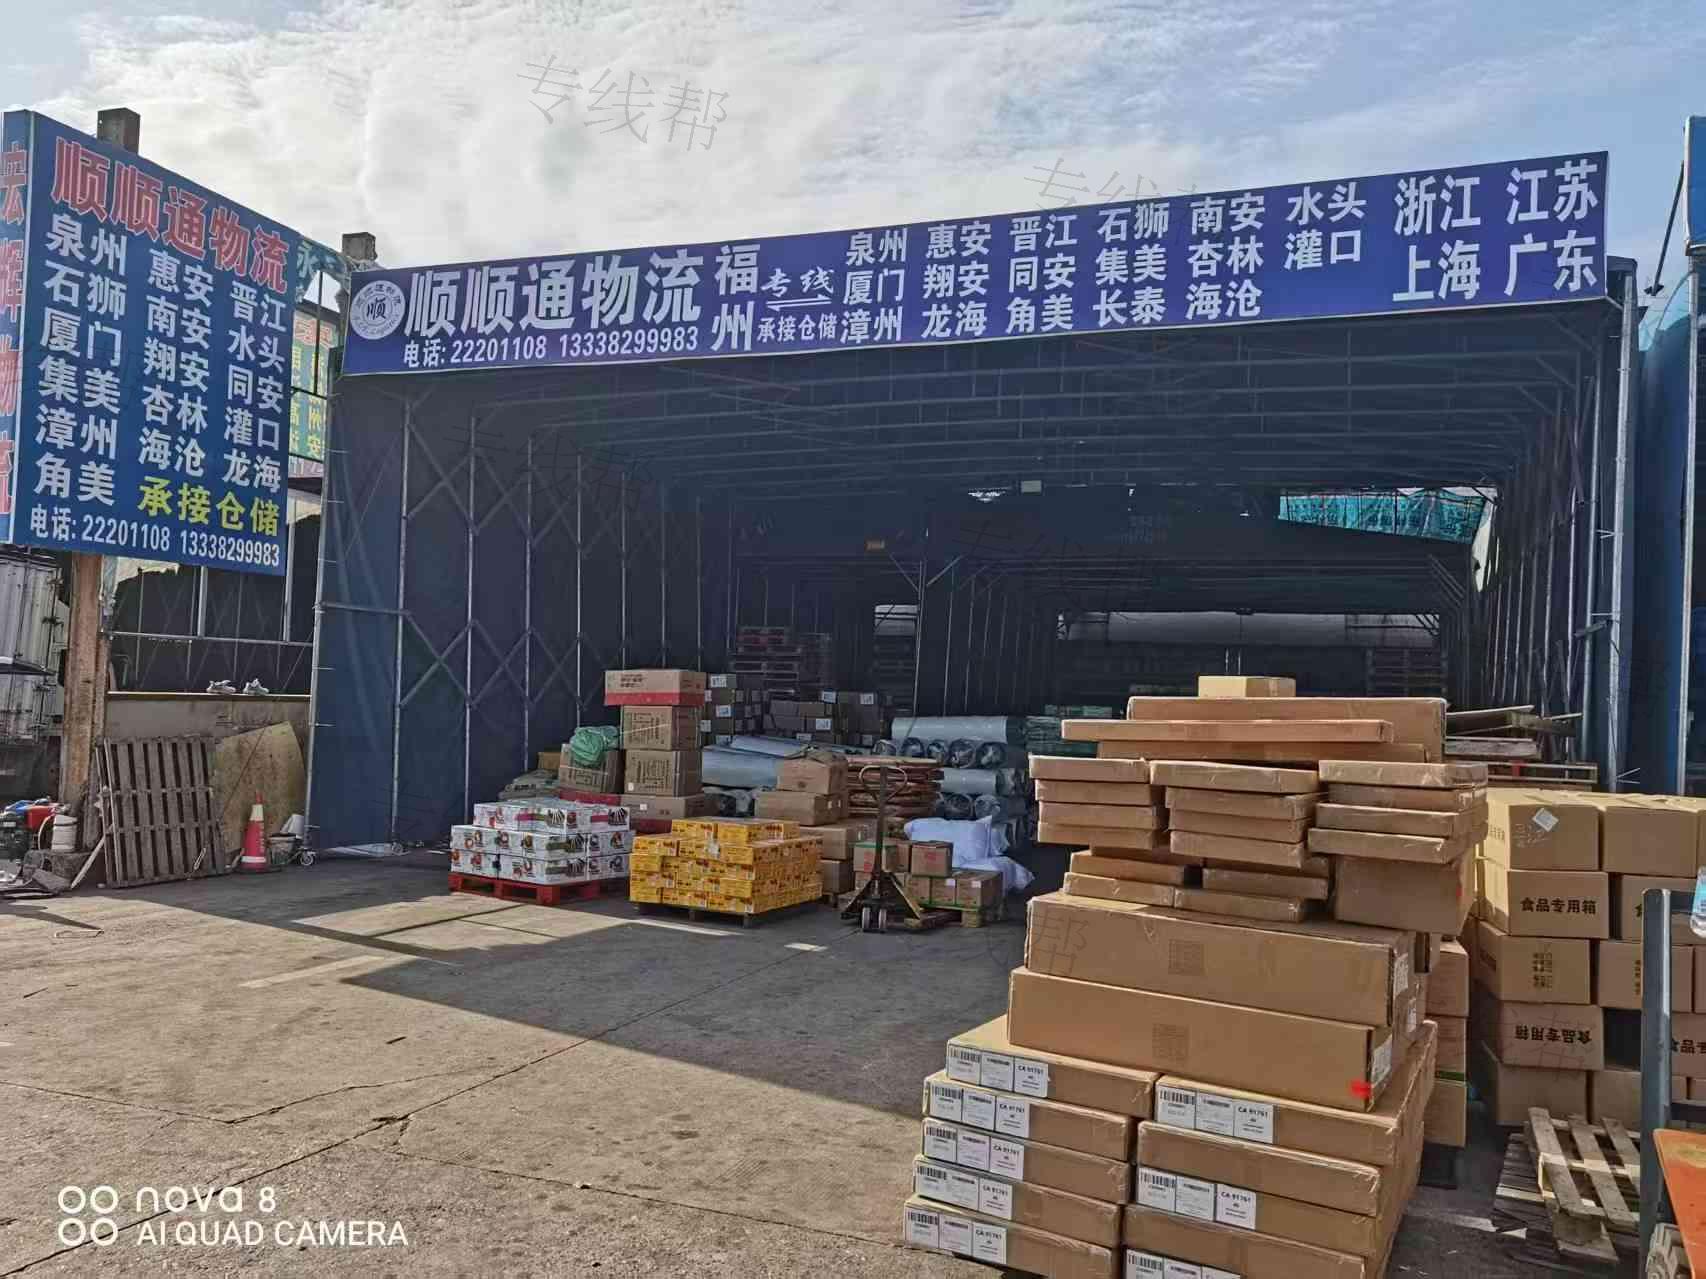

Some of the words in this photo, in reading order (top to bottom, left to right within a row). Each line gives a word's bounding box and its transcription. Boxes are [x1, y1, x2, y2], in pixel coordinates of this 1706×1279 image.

[51, 136, 288, 295] 顺顺通物流
[1190, 192, 1265, 234] 南安
[1286, 182, 1367, 226] 水头
[1394, 174, 1481, 236] 浙江
[1506, 159, 1599, 224] 江苏
[46, 213, 127, 277] 泉州
[925, 221, 992, 258] 惠安
[1009, 213, 1078, 252] 晋江
[1097, 201, 1171, 244] 石狮
[845, 228, 908, 267] 泉州
[1096, 244, 1168, 286] 集美
[1187, 235, 1265, 278] 杏林
[1284, 227, 1362, 270] 灌口
[1392, 239, 1481, 302] 上海
[1504, 229, 1598, 296] 广东
[42, 260, 128, 322] 石狮
[146, 248, 214, 307] 惠安
[404, 248, 703, 337] 顺顺通物流
[760, 266, 835, 298] 专线
[843, 267, 905, 306] 厦门
[923, 260, 990, 299] 翔安
[1008, 253, 1077, 292] 同安
[229, 279, 287, 334] 晋江
[711, 243, 761, 352] 福州
[921, 301, 987, 339] 龙海
[1006, 294, 1073, 334] 角美
[1093, 286, 1166, 327] 长泰
[1185, 280, 1263, 320] 海沧
[39, 308, 122, 368] 厦门
[145, 295, 212, 350] 南安
[451, 336, 547, 364] 22201108
[559, 326, 699, 358] 13338299983
[757, 311, 838, 344] 承接仓储
[840, 307, 901, 345] 漳州
[143, 337, 210, 393] 翔安
[227, 324, 286, 375] 水头
[37, 355, 121, 416] 集美
[141, 384, 208, 435] 杏林
[228, 365, 285, 414] 同安
[35, 404, 118, 461] 漳州
[138, 426, 207, 477] 海沧
[223, 407, 281, 451] 灌口
[33, 454, 115, 507] 角美
[221, 448, 282, 495] 龙海
[136, 477, 278, 538] 承接仓储
[82, 514, 171, 553] 22201108
[179, 529, 280, 569] 13338299983
[1520, 896, 1597, 915] 食品专用箱
